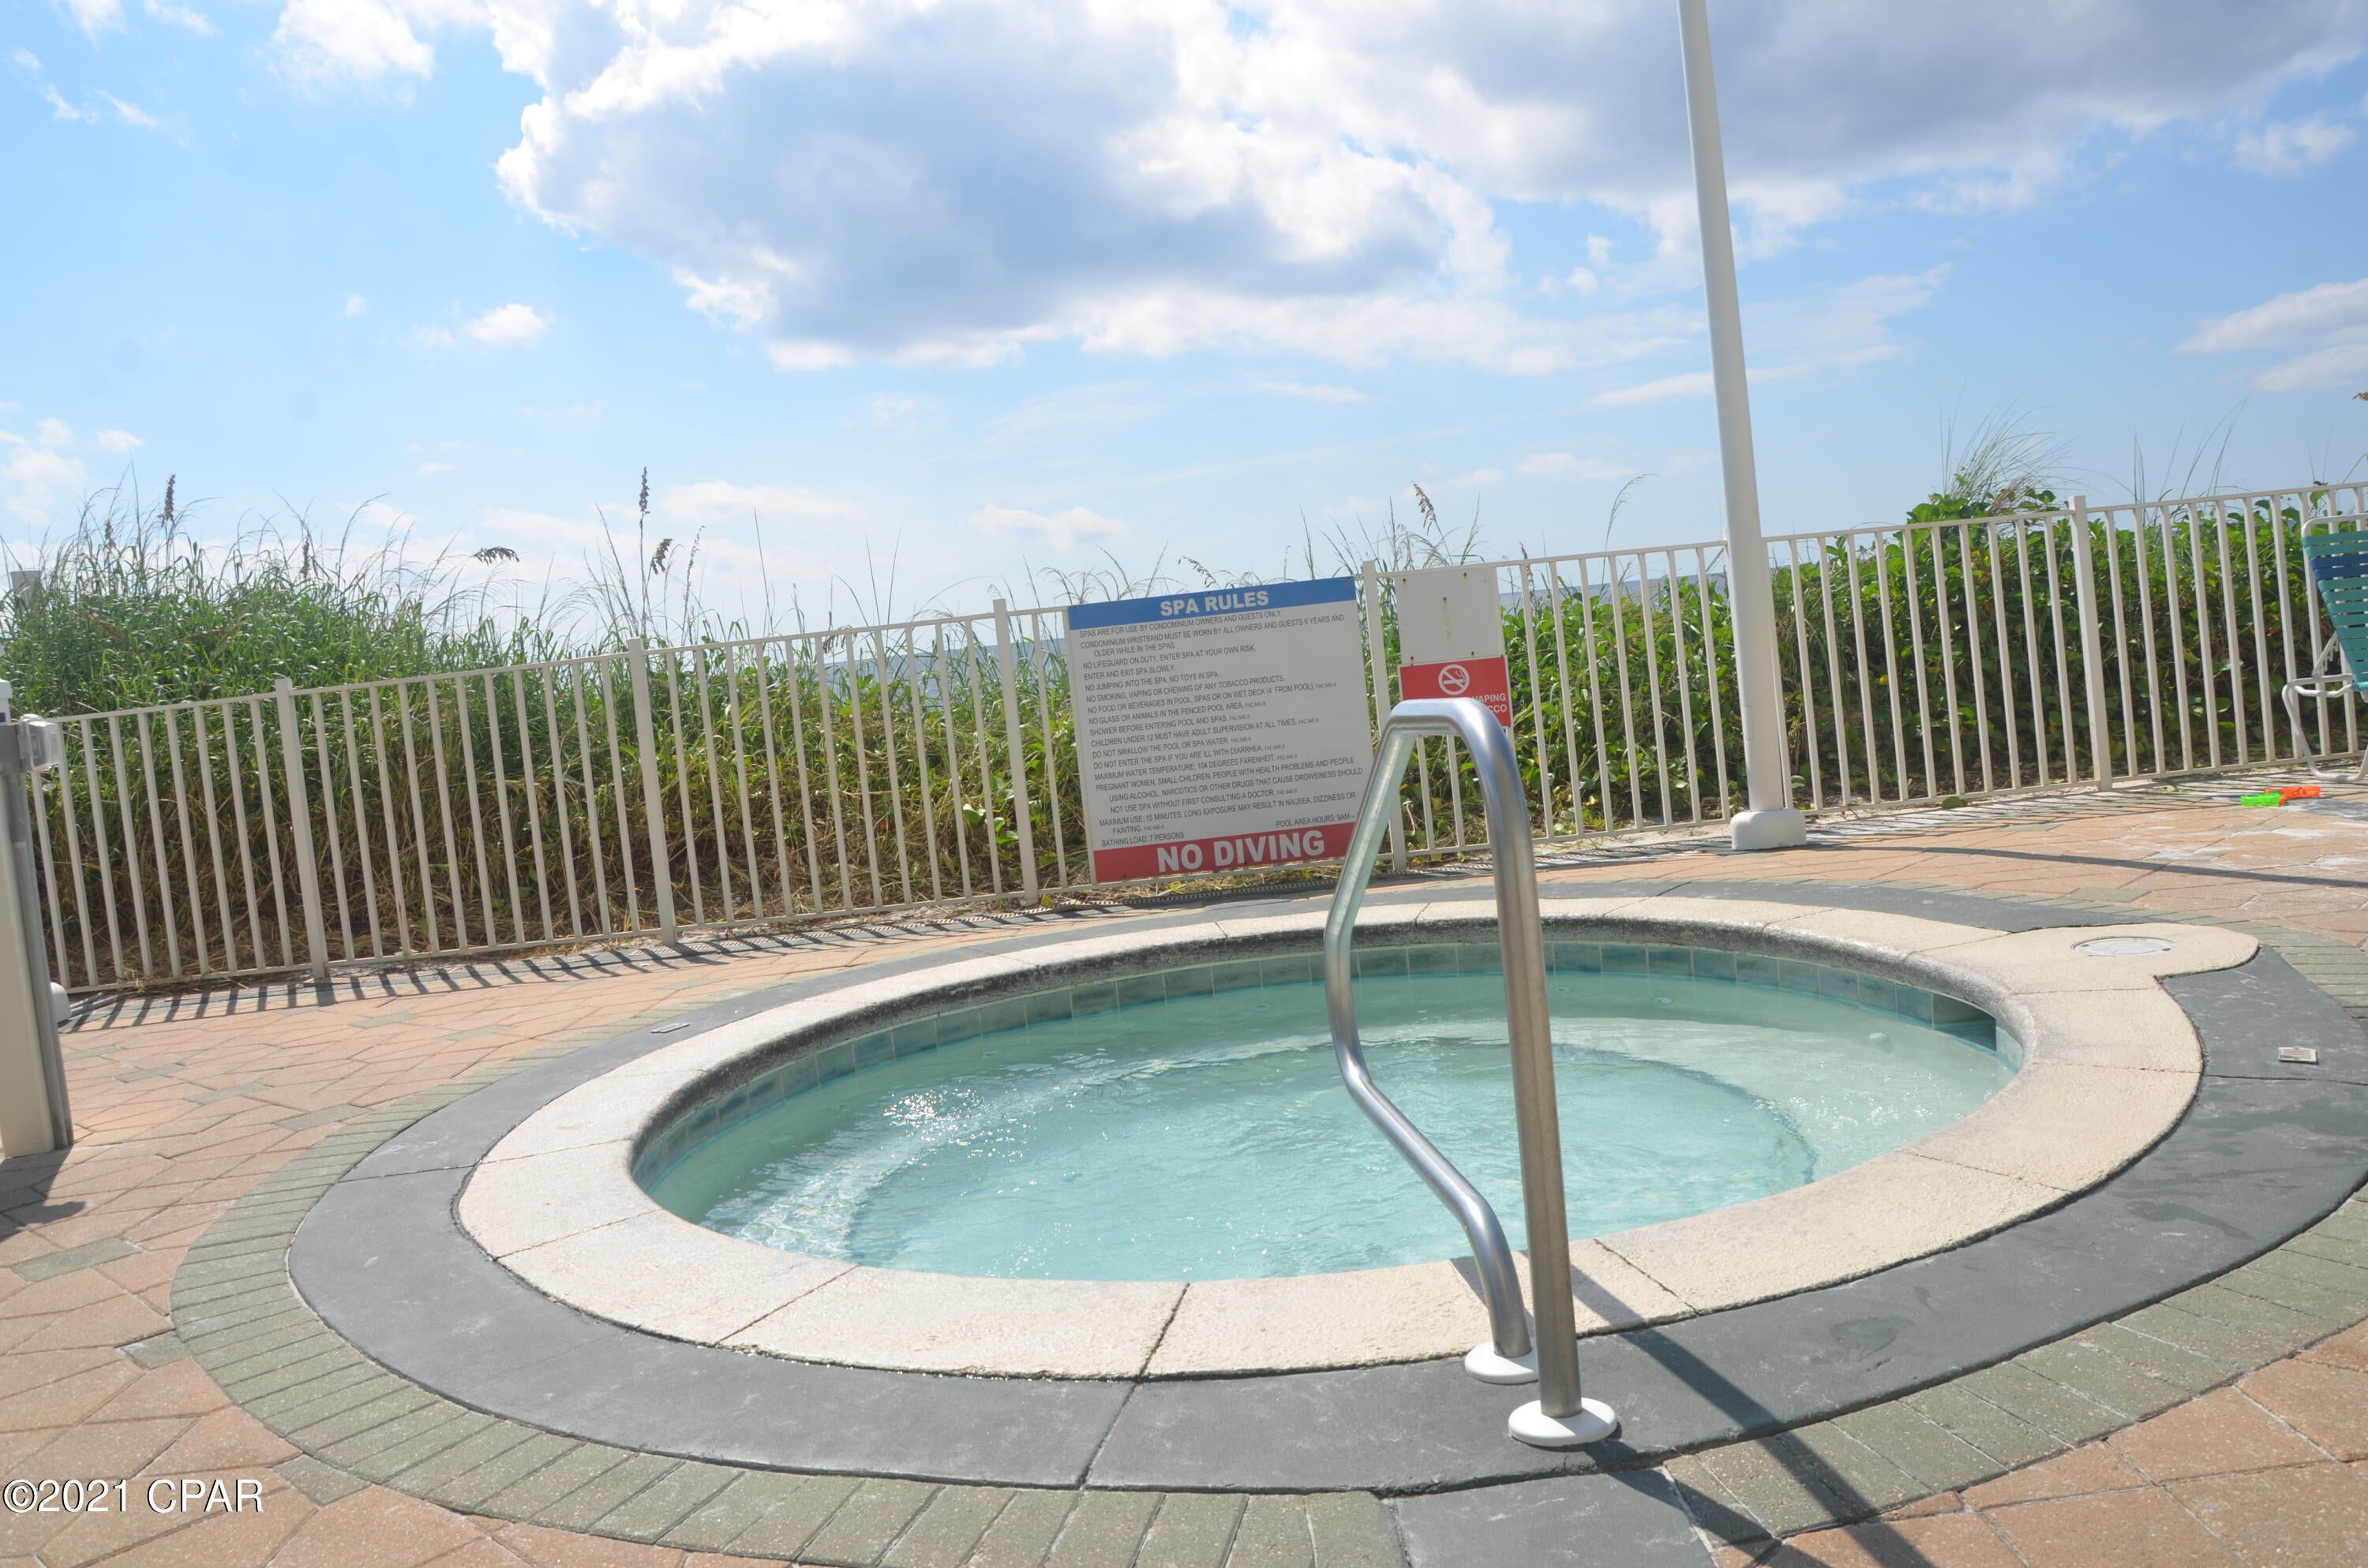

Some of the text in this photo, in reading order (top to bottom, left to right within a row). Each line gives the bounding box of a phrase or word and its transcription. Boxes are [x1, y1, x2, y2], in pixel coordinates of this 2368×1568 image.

[1160, 590, 1268, 616] SPA RULES
[1149, 619, 1193, 630] CONDOMINIUM
[1195, 616, 1222, 625] OWNERS
[1238, 612, 1263, 620] GUESTS
[1080, 638, 1126, 649] CONDOMINIUM
[1126, 634, 1163, 644] WRISTBAND
[1192, 628, 1212, 637] WORN
[1235, 623, 1262, 632] OWNERS
[1277, 618, 1303, 627] GUESTS
[1309, 616, 1330, 624] YEARS
[1092, 657, 1128, 668] LIFEGUARD
[1159, 652, 1181, 661] ENTER
[1205, 647, 1223, 656] YOUR
[1093, 648, 1115, 657] OLDER
[1115, 646, 1135, 654] WHILE
[1083, 672, 1104, 680] ENTER
[1096, 681, 1123, 690] JUMPING
[1128, 689, 1152, 698] VAPING
[1163, 684, 1193, 694] CHEWING
[1218, 679, 1249, 688] TOBACCO
[1097, 704, 1116, 713] FOOD
[1127, 698, 1165, 709] BEVERAGES
[1274, 685, 1293, 694] FROM
[1099, 715, 1119, 724] GLASS
[1131, 711, 1159, 720] ANIMALS
[1180, 705, 1206, 714] FENCED
[1089, 726, 1117, 735] SHOWER
[1118, 724, 1143, 732] BEFORE
[1145, 720, 1176, 730] ENTERING
[1090, 737, 1122, 747] CHILDREN
[1122, 735, 1145, 743] UNDER
[1212, 723, 1254, 733] SUPERVISION
[1117, 746, 1148, 755] SWALLOW
[1163, 742, 1180, 750] POOL
[1094, 770, 1124, 780] MAXIMUM
[1124, 768, 1147, 777] WATER
[1208, 758, 1238, 768] DEGREES
[1118, 758, 1139, 766] ENTER
[1095, 781, 1129, 791] PREGNANT
[1157, 776, 1177, 784] SMALL
[1212, 769, 1237, 778] PEOPLE
[1238, 767, 1254, 776] WITH
[1255, 765, 1280, 773] HEALTH
[1280, 761, 1314, 771] PROBLEMS
[1329, 756, 1354, 765] PEOPLE
[1108, 793, 1129, 802] USING
[1161, 785, 1197, 795] NARCOTICS
[1208, 782, 1231, 791] OTHER
[1231, 779, 1254, 788] DRUGS
[1272, 775, 1293, 784] CAUSE
[1294, 770, 1336, 781] DROWSINESS
[1337, 767, 1362, 777] SHOULD
[1099, 817, 1129, 826] MAXIMUM
[1183, 808, 1202, 817] LONG
[1202, 805, 1236, 814] EXPOSURE
[1252, 800, 1276, 809] RESULT
[1313, 792, 1345, 803] DIZZINESS
[1152, 799, 1180, 809] WITHOUT
[1181, 797, 1199, 806] FIRST
[1201, 793, 1241, 803] CONSULTING
[1276, 819, 1291, 828] POOL
[1101, 831, 1184, 846] BATHING PERSONS
[1157, 830, 1325, 873] NO DIVING
